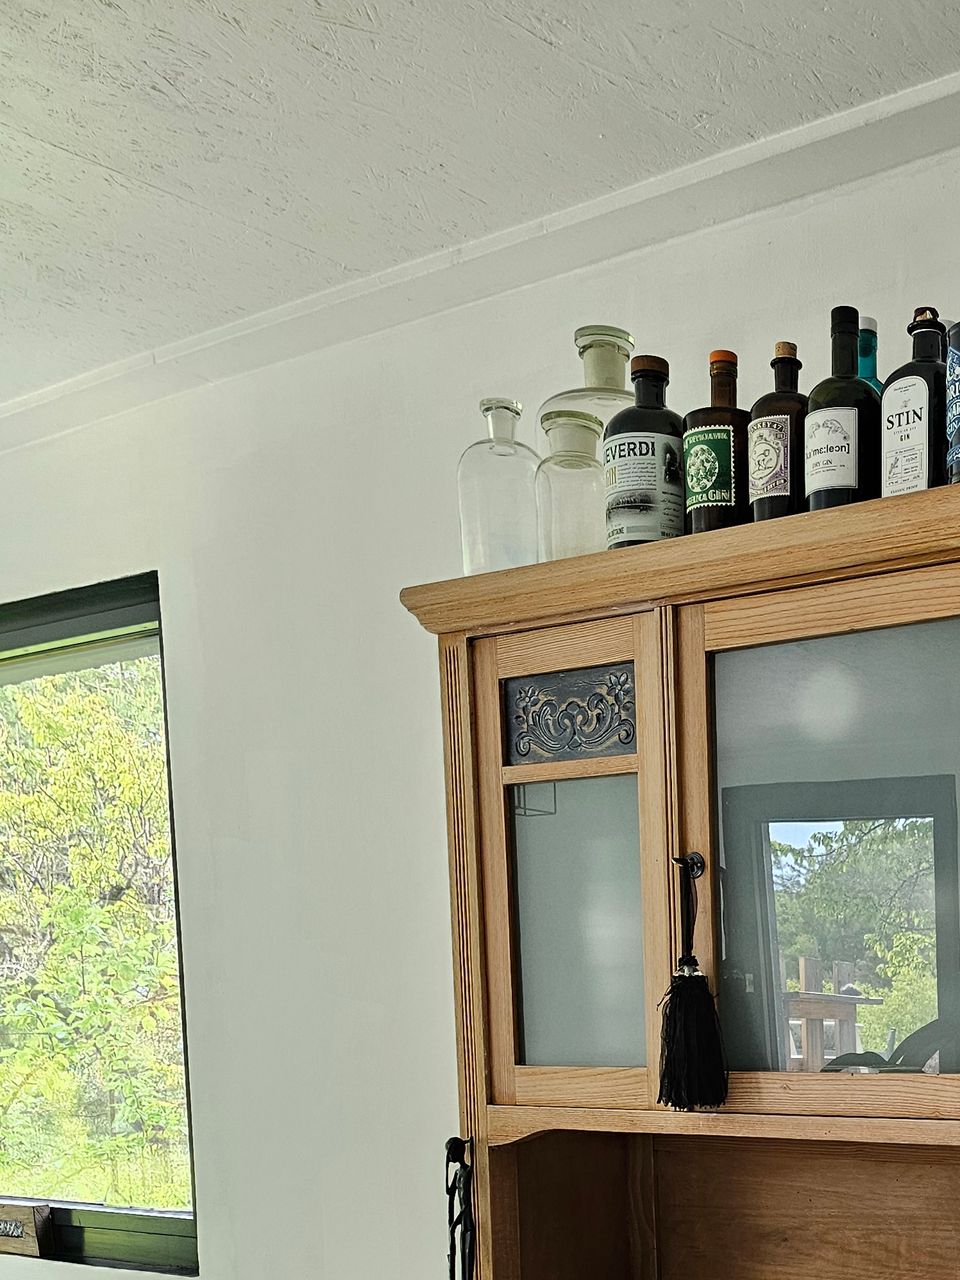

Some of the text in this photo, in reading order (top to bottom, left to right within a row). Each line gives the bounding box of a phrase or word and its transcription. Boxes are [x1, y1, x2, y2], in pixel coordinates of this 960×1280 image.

[886, 406, 924, 431] STIN
[604, 441, 656, 466] EVERDI
[708, 489, 730, 501] GIN
